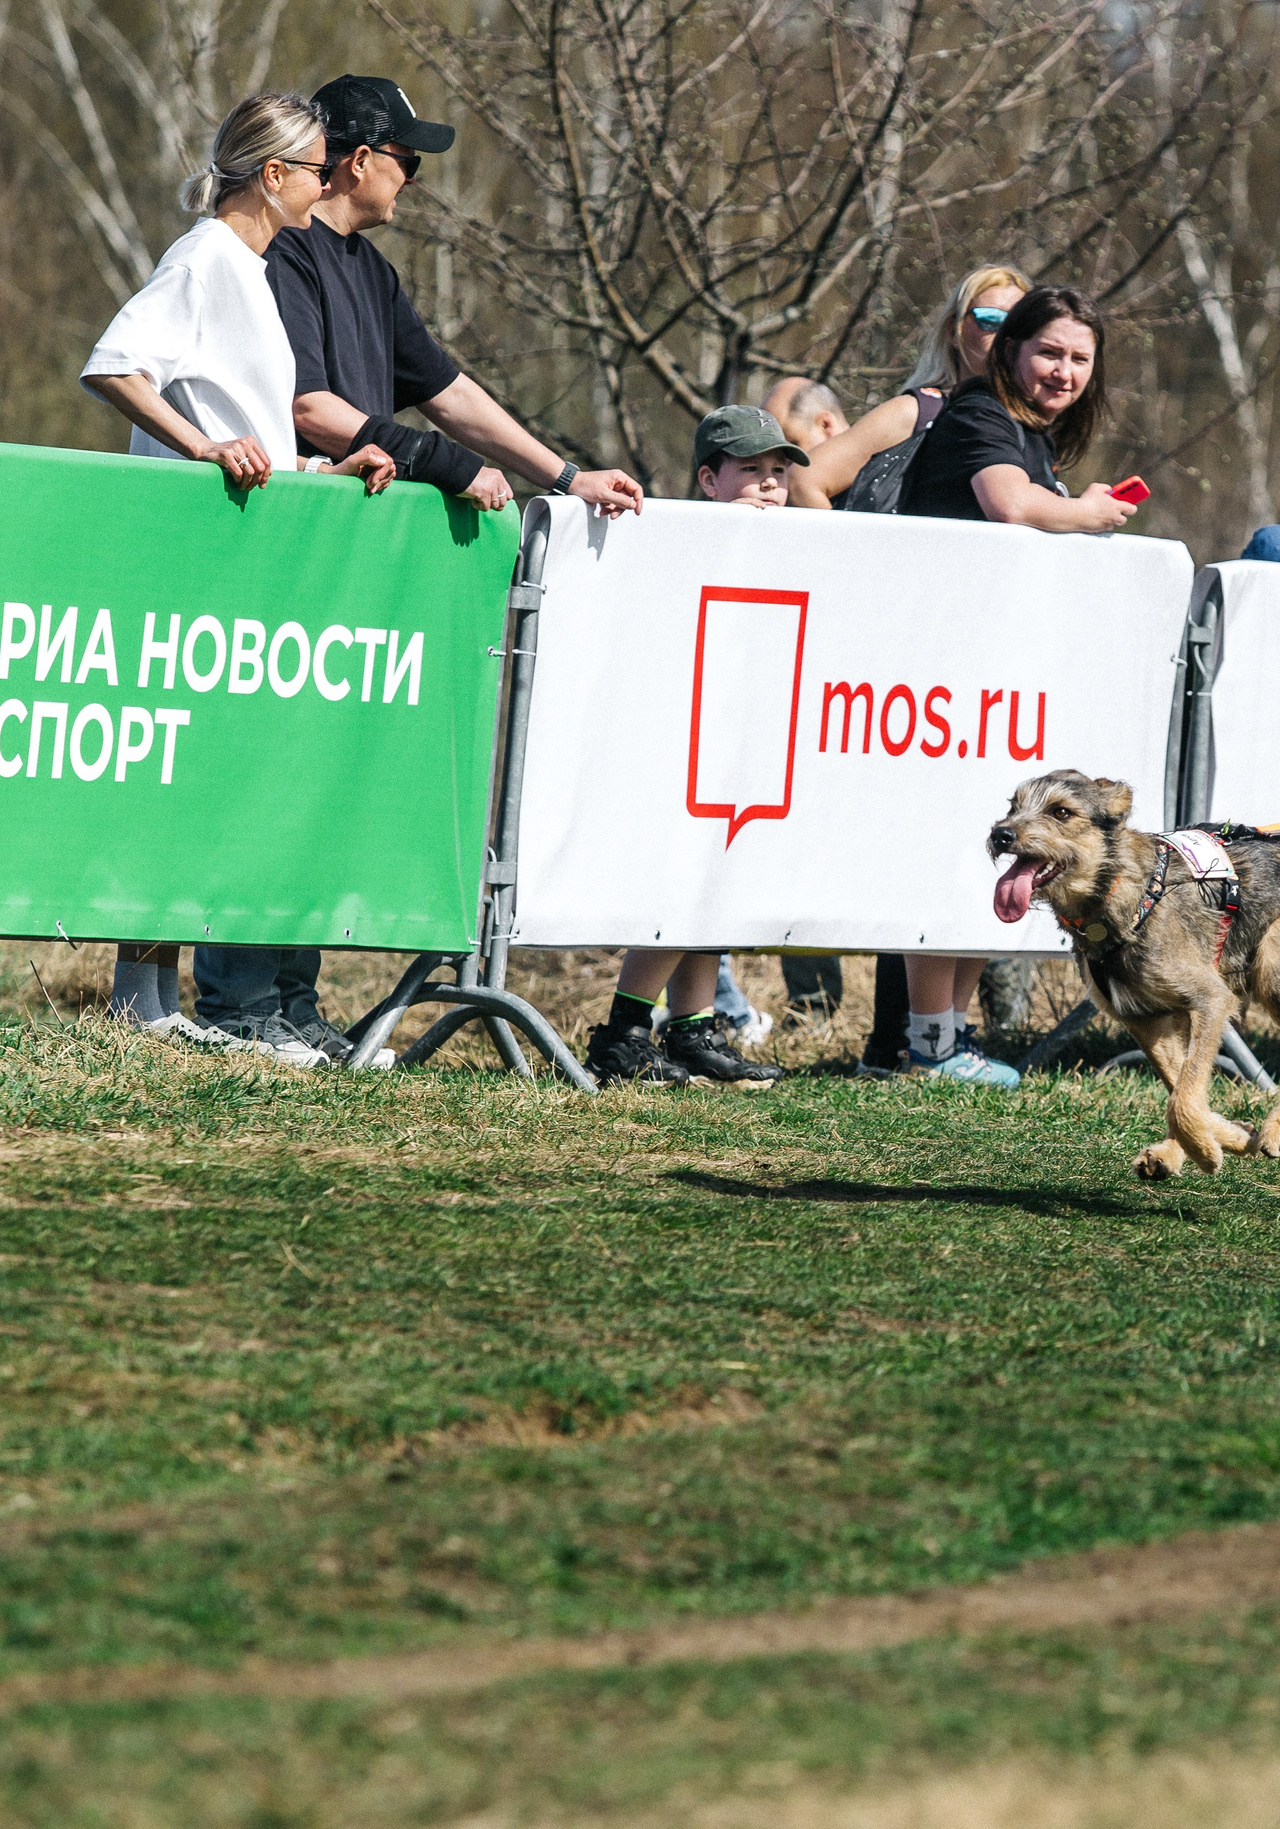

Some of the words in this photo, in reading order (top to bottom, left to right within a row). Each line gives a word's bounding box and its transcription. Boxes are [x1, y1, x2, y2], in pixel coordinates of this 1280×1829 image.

[0, 601, 119, 686] РИА
[137, 611, 425, 706] НОВОСТИ
[0, 698, 191, 785] СПОРТ
[818, 681, 1047, 762] mos.ru
